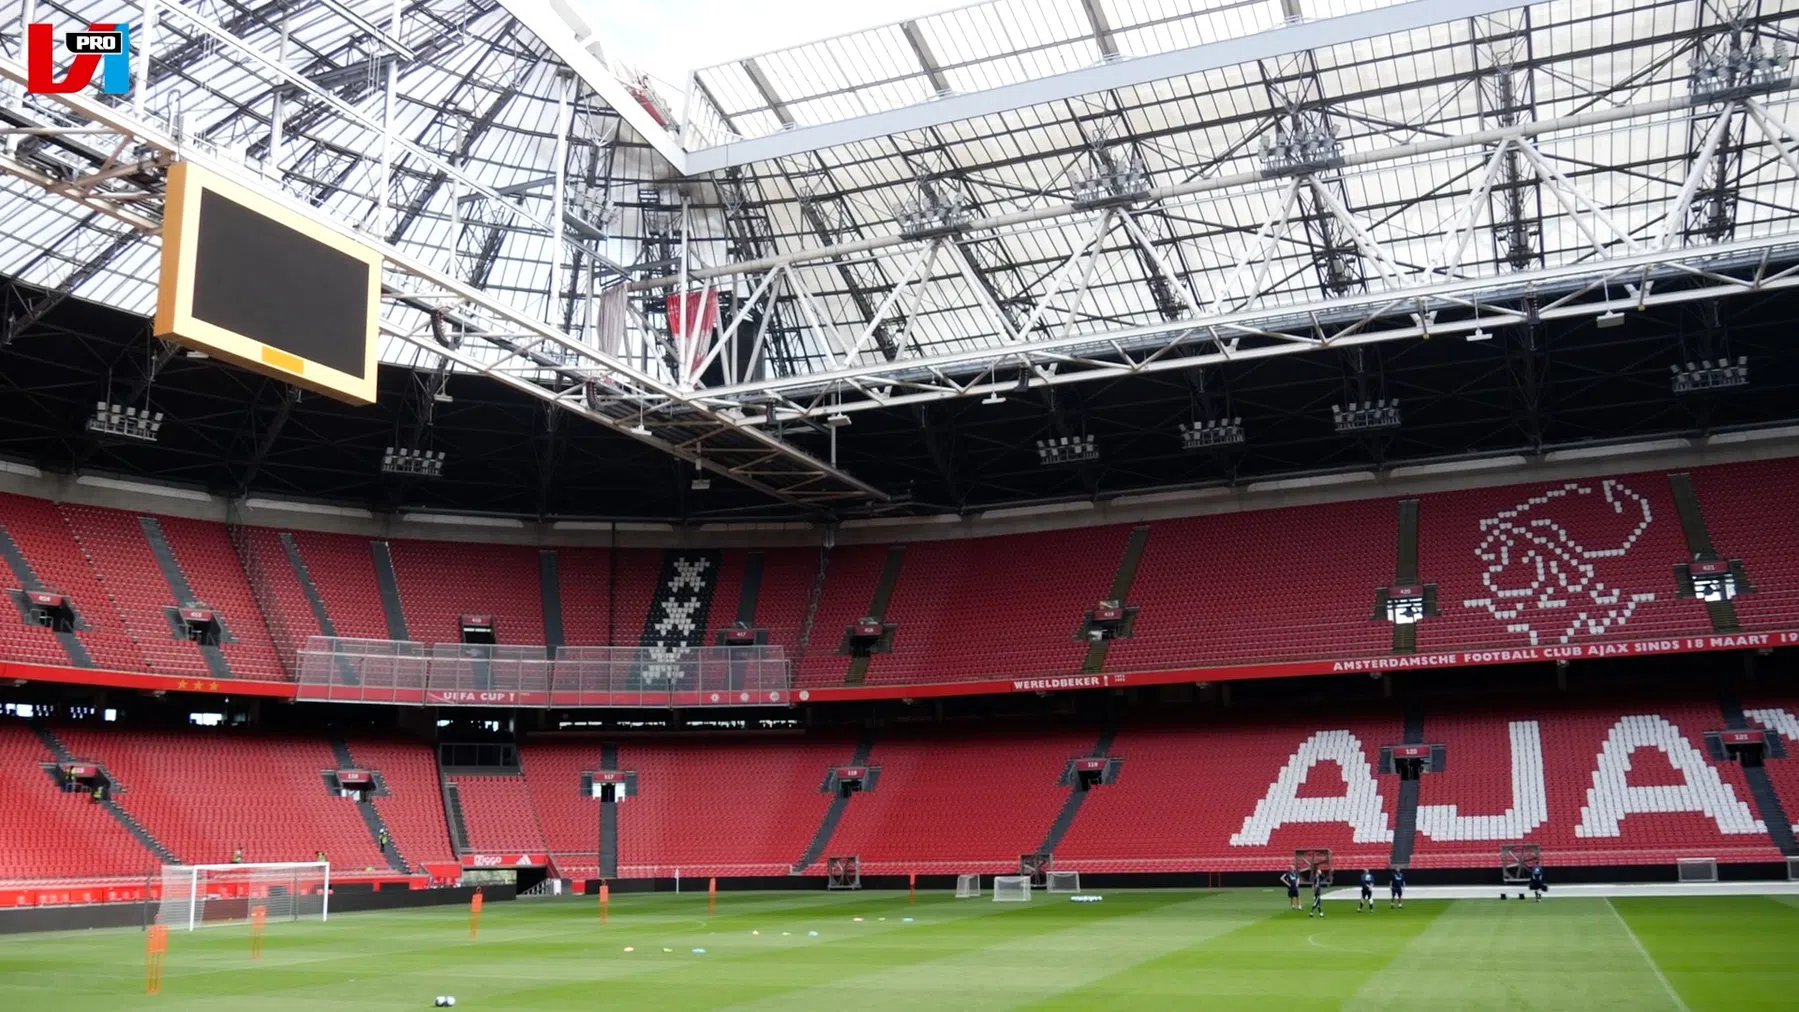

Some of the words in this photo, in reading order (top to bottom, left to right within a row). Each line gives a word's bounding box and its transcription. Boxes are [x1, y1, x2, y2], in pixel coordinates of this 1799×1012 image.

[1333, 654, 1456, 671] AMSTERDAMSCHE
[1463, 649, 1538, 663] FOOTBALL
[1543, 646, 1581, 658] CLUB
[1588, 643, 1629, 656] AJAX
[1634, 639, 1680, 652] SINDS
[1687, 639, 1704, 649] 18
[1710, 634, 1769, 647] MAART
[1013, 676, 1100, 690] WERELDBEKER
[443, 691, 475, 701] UEFA
[480, 692, 505, 701] CUP
